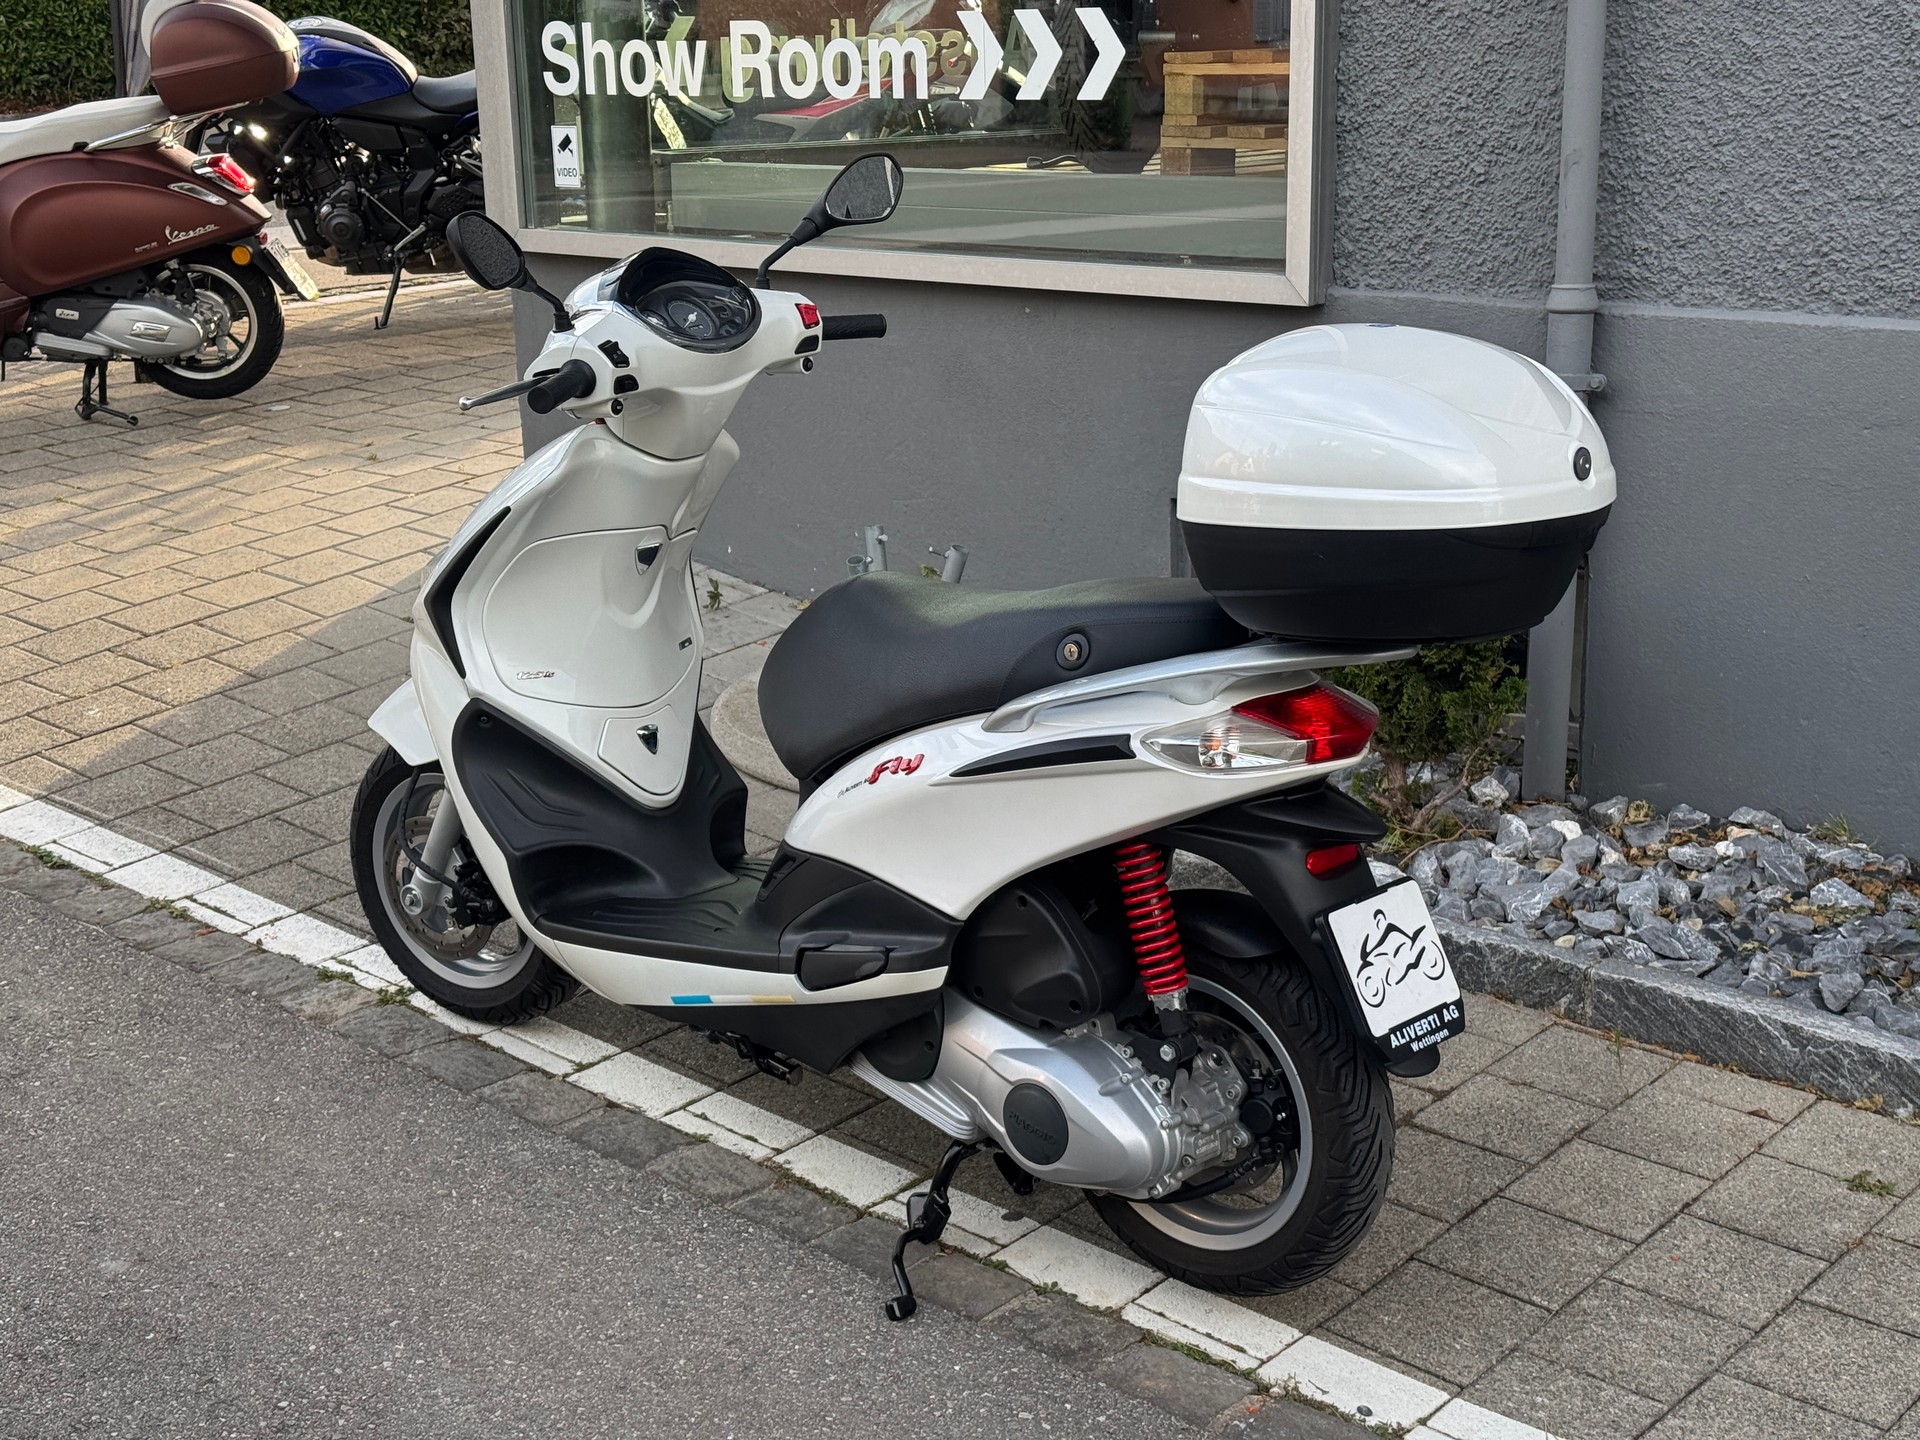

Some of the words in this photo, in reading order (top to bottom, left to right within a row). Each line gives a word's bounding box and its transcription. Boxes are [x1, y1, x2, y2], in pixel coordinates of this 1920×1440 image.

[541, 20, 707, 97] Show
[729, 20, 928, 99] Room
[556, 168, 578, 178] VIDEO
[165, 225, 220, 245] Vespa
[868, 753, 924, 784] Fly
[1390, 1013, 1440, 1048] ALIVERTI
[1442, 1005, 1459, 1022] AG
[1410, 1028, 1449, 1052] Wettingen
